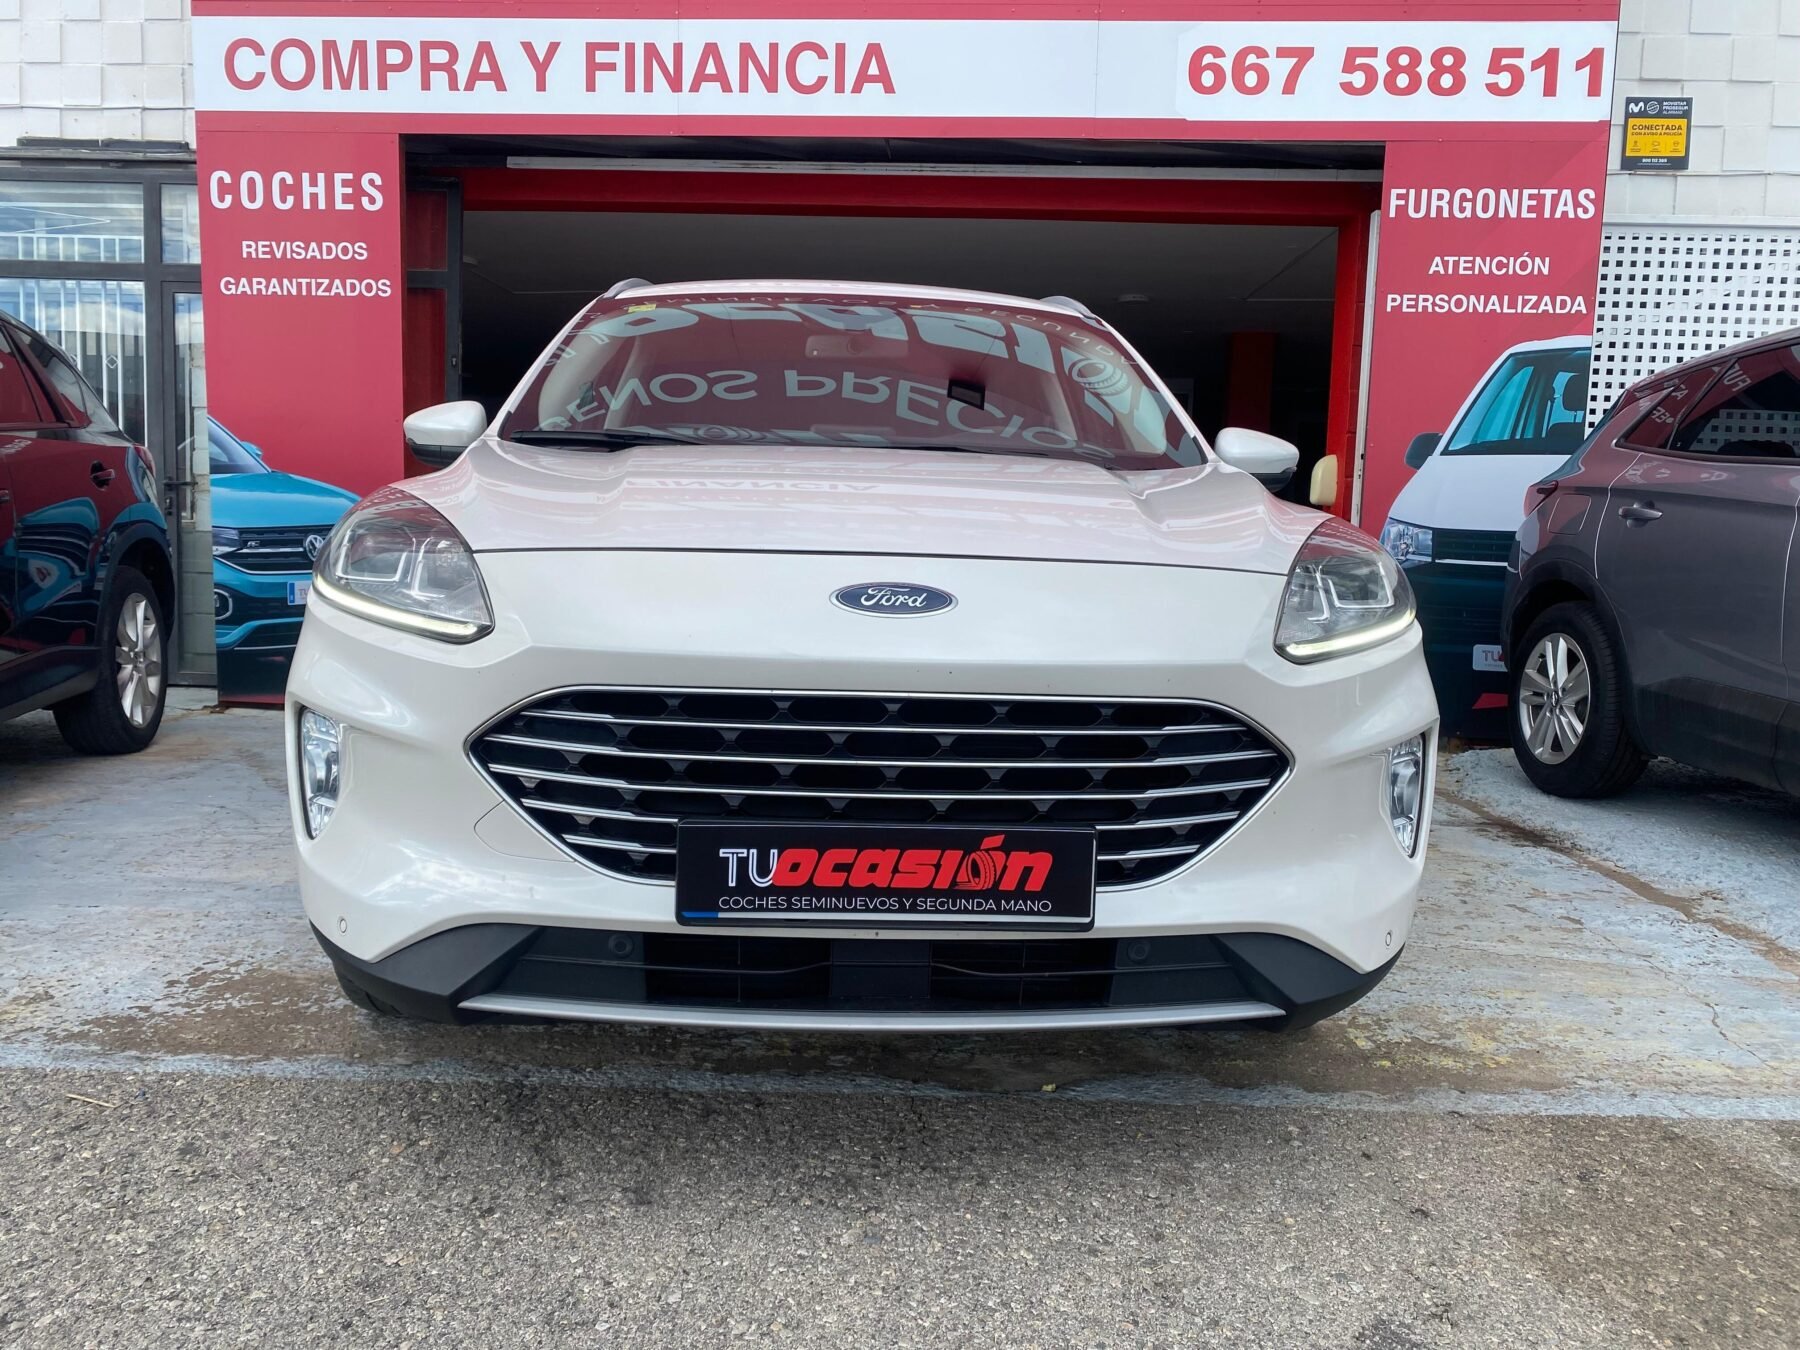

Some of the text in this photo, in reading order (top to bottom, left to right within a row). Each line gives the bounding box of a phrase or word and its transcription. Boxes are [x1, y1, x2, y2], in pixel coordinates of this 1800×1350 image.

[224, 37, 896, 95] COMPRA Y FINANCIA
[1187, 45, 1605, 98] 667 588 511
[208, 169, 384, 212] COCHES
[1388, 187, 1596, 220] FURGONETAS
[241, 240, 369, 261] REVISADOS
[1428, 253, 1550, 277] ATENCIÓN
[219, 276, 392, 298] GARANTIZADOS
[1386, 294, 1588, 315] PERSONALIZADA
[860, 586, 928, 608] Ford
[718, 895, 1052, 913] COCHES SEMINUEVOS Y SEGUNDA MANO
